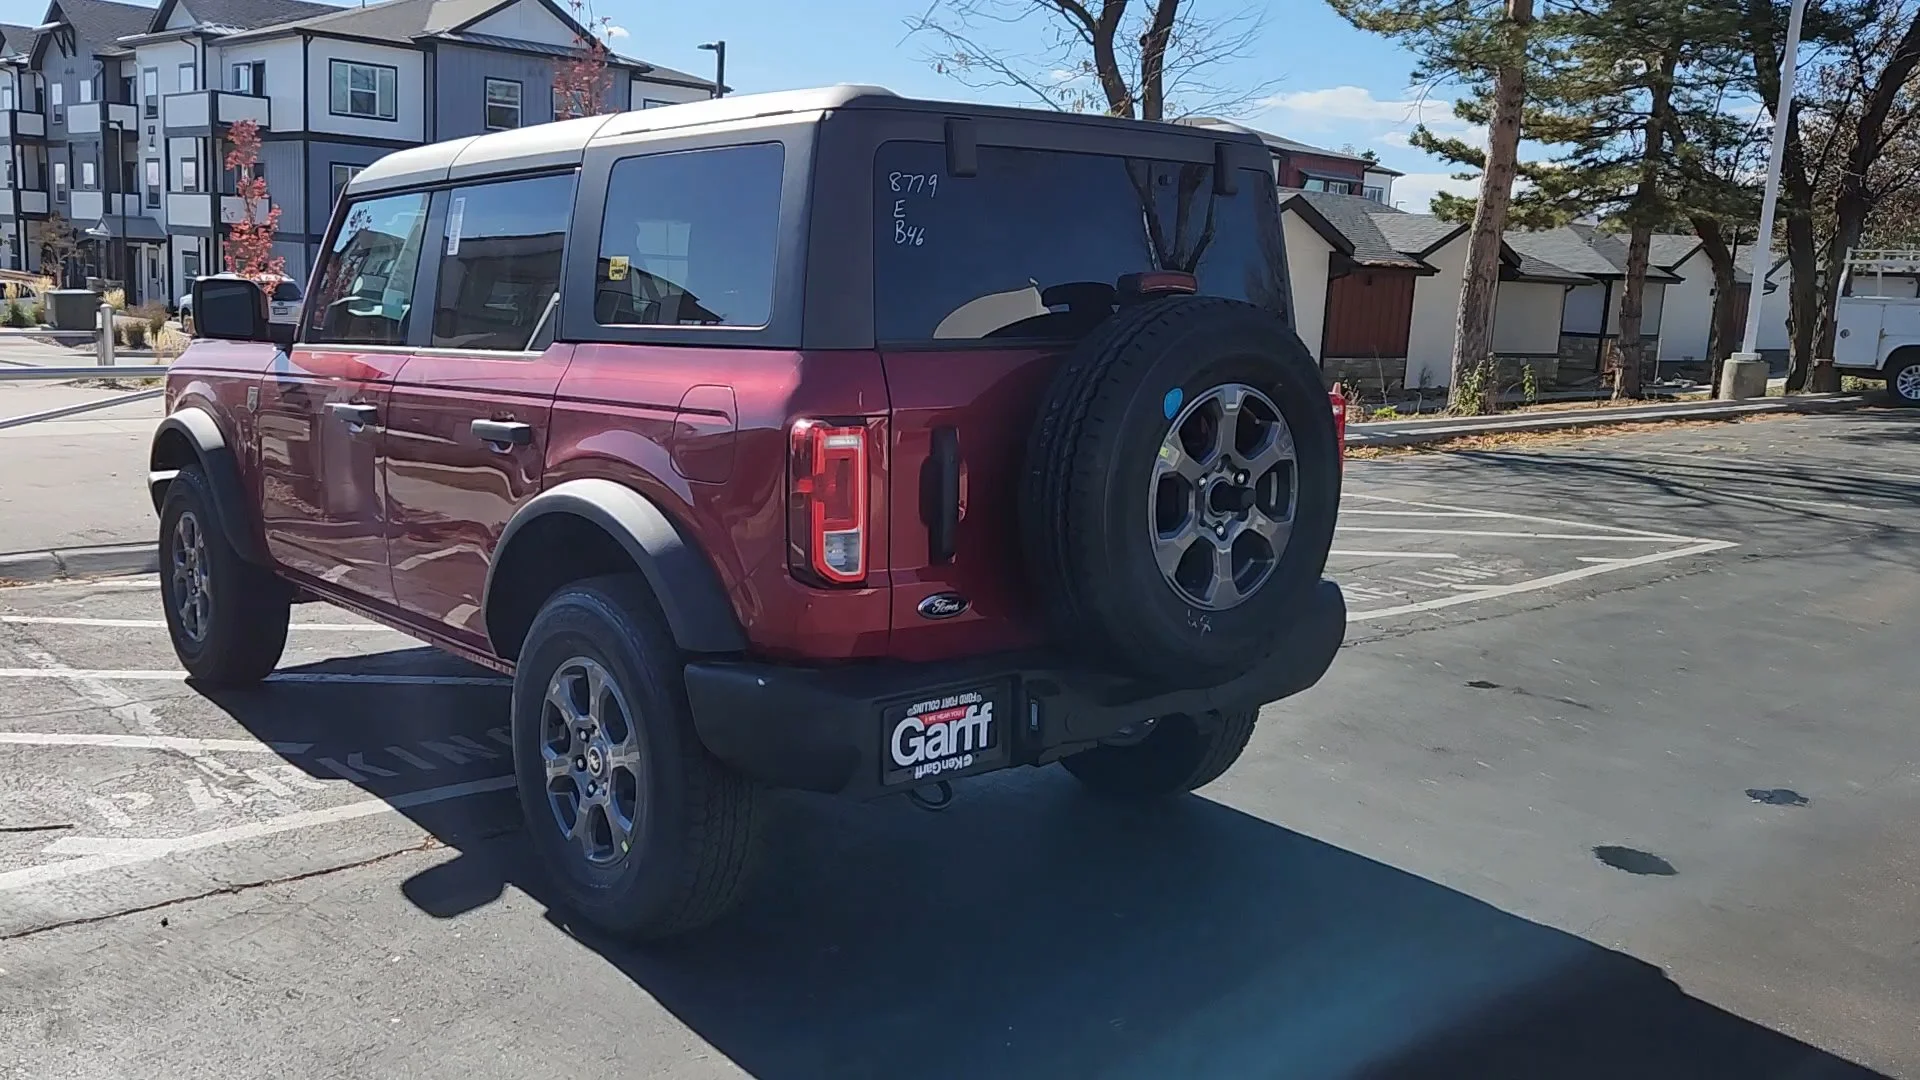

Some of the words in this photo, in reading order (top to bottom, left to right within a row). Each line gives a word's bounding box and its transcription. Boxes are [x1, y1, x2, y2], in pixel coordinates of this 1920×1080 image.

[889, 172, 937, 198] 8779
[893, 199, 906, 218] E
[895, 220, 925, 246] B46
[931, 598, 960, 614] Ford
[941, 695, 958, 707] FORT
[959, 691, 977, 704] FORD
[913, 699, 940, 714] COLLINS
[891, 702, 993, 767] Garff
